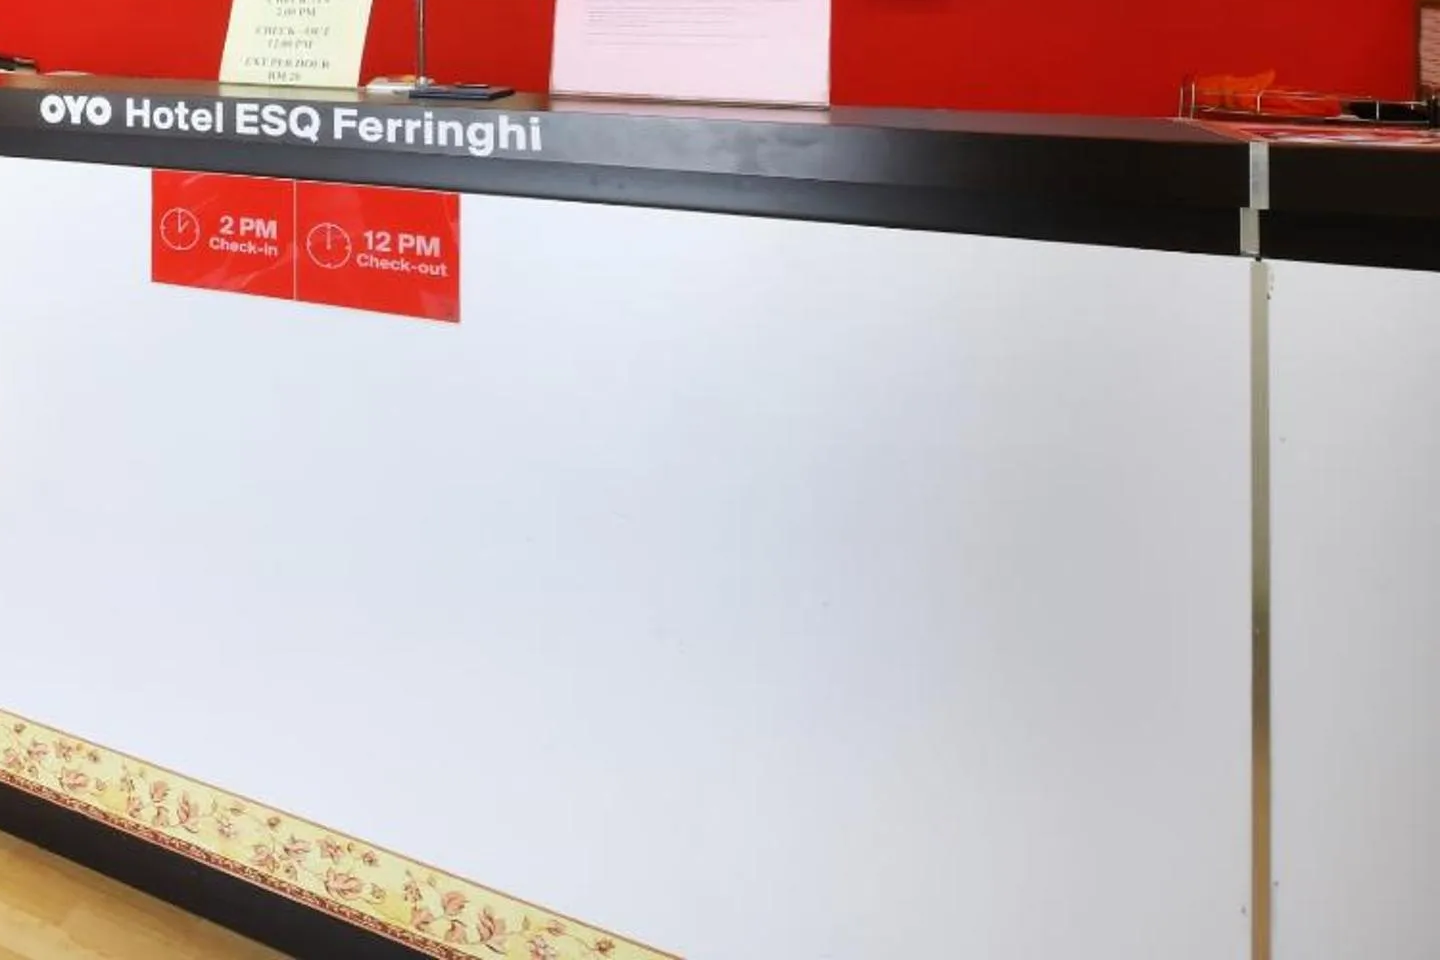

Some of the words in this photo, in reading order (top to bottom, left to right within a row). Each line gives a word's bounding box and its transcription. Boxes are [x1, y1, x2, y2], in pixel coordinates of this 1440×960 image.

[40, 95, 112, 126] OYO
[125, 99, 224, 134] Hotel
[235, 104, 321, 141] ESQ
[333, 108, 542, 157] Ferringhi
[220, 215, 235, 235] 2
[239, 216, 277, 240] PM
[208, 236, 278, 258] Check-in
[364, 230, 391, 252] 12
[398, 233, 441, 258] PM
[356, 253, 449, 277] Check-out
